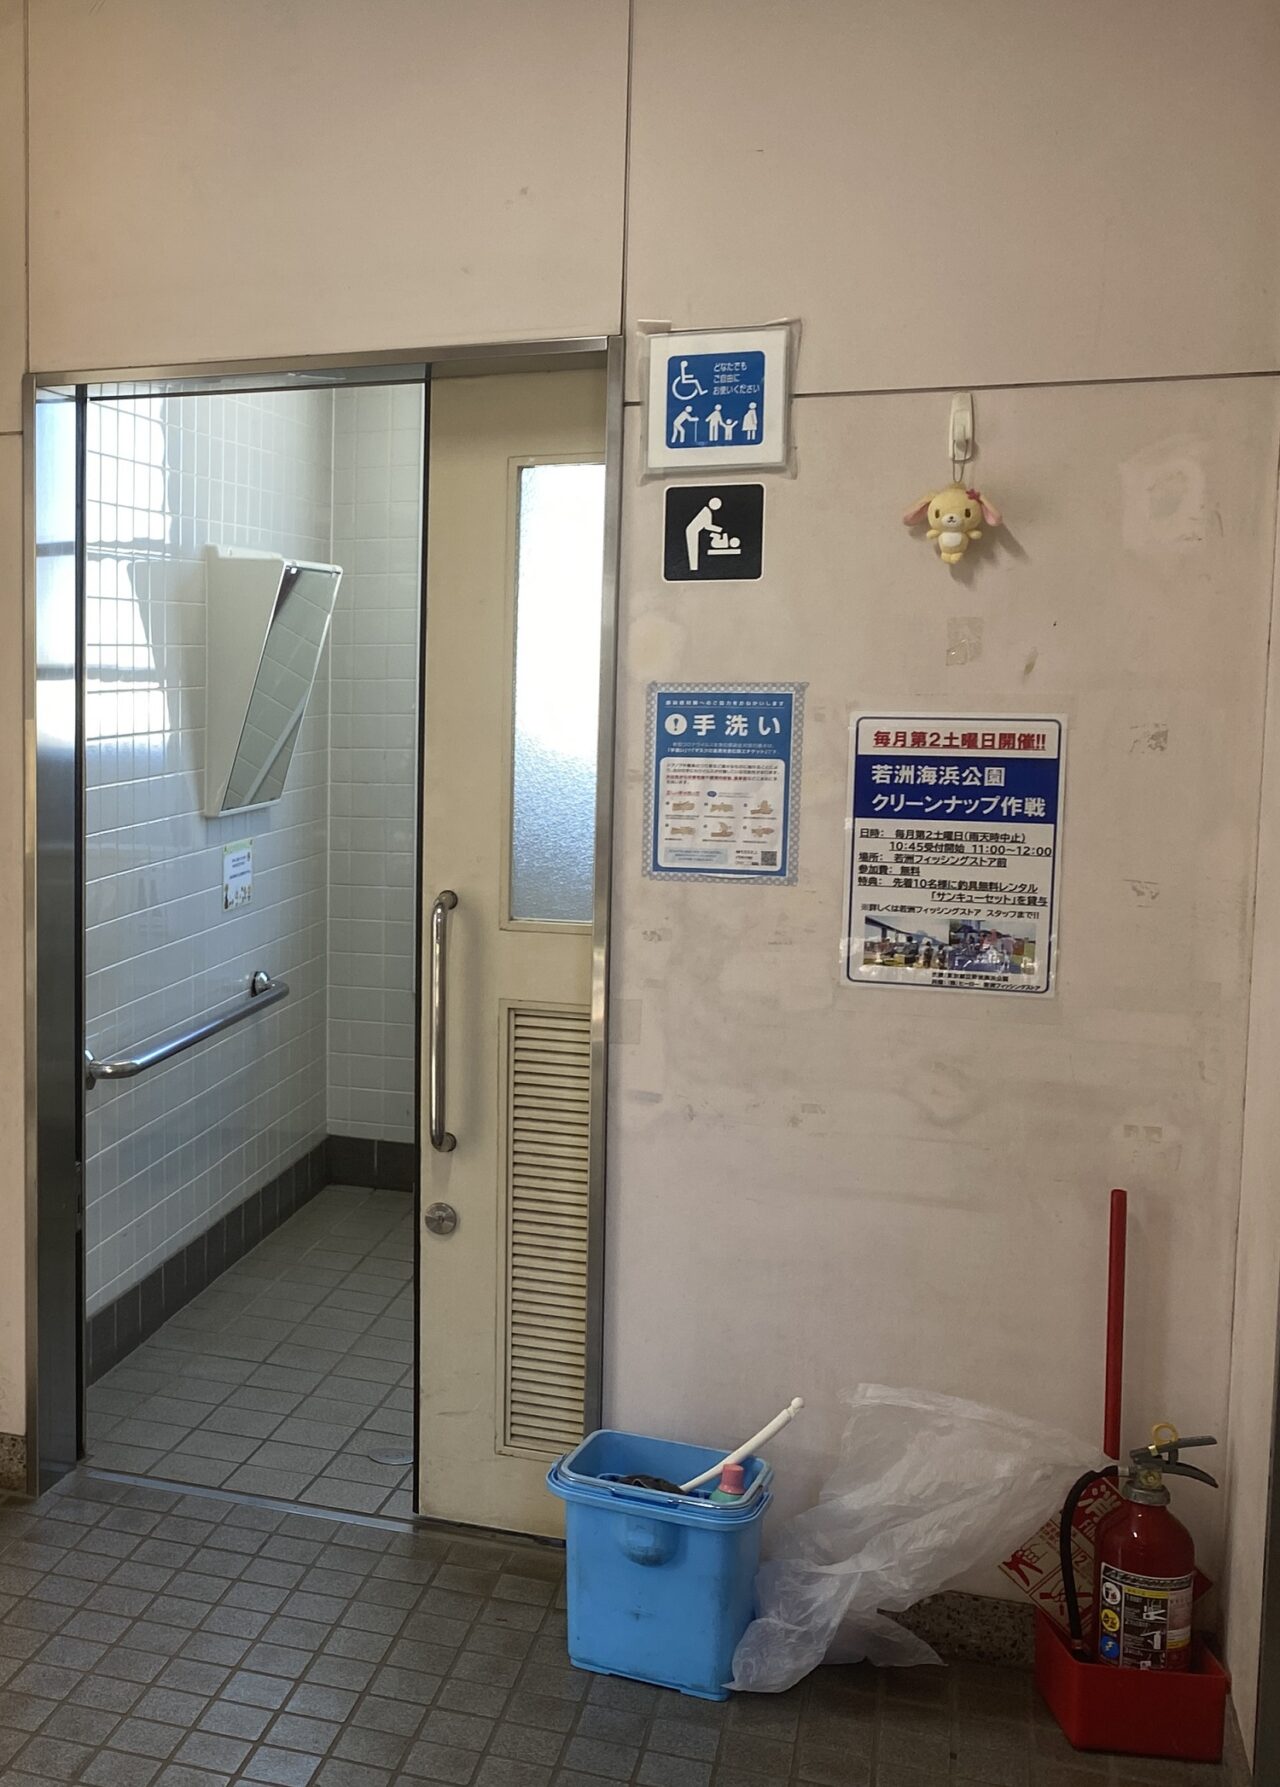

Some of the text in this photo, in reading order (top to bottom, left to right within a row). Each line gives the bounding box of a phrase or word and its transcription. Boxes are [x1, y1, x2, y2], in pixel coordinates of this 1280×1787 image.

[713, 361, 748, 372] どなたでも
[713, 373, 741, 383] ご自由に
[712, 384, 760, 396] お使いください
[692, 714, 781, 736] 手洗い
[872, 764, 1006, 787] 若洲海浜公園
[872, 793, 1047, 817] クリーンナップ作戦
[894, 853, 1008, 868] 若洲フィッシングストア前
[900, 866, 920, 876] 無料
